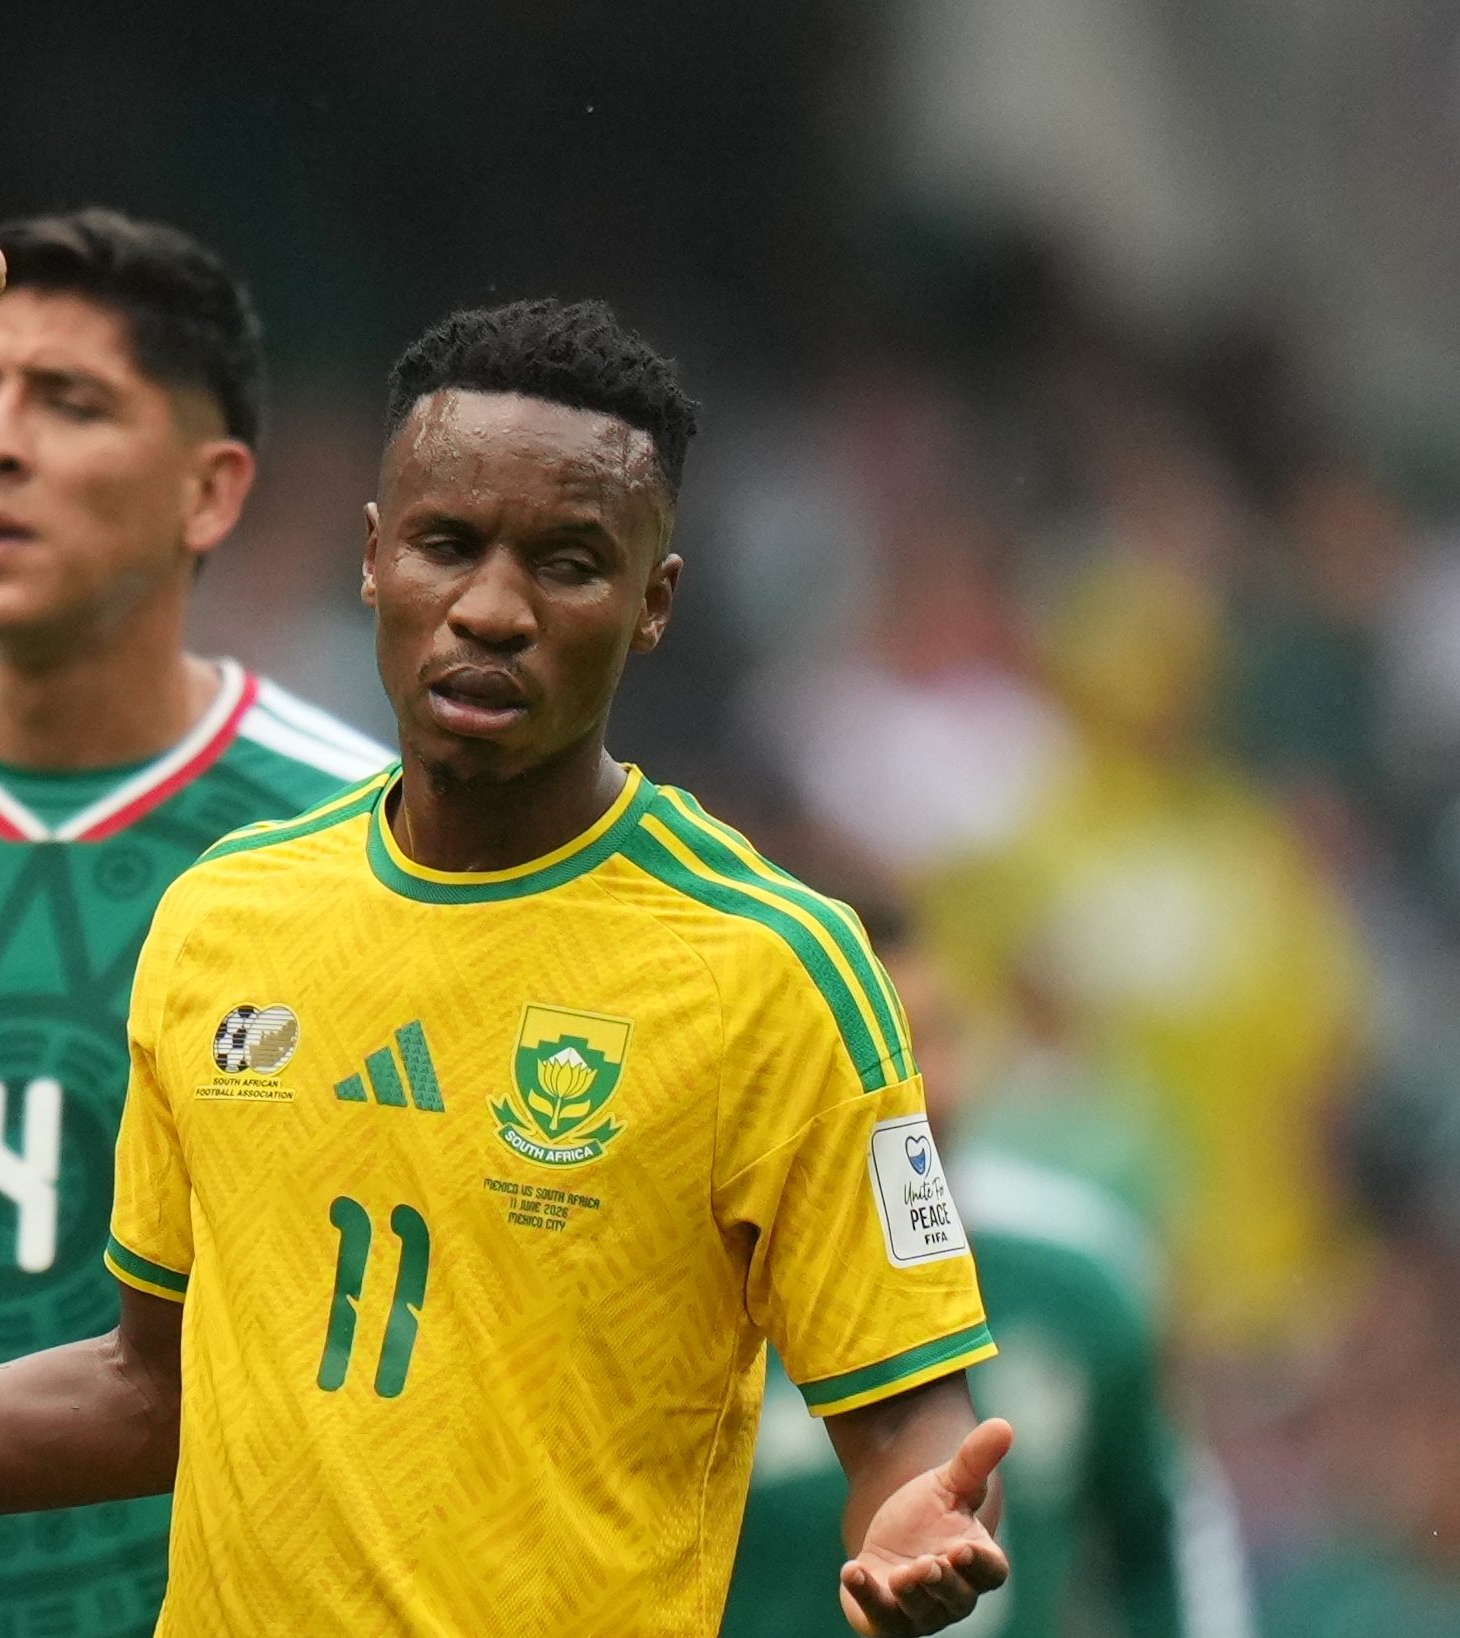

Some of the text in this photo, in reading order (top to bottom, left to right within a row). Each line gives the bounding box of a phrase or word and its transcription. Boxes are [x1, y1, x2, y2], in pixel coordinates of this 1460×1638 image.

[195, 1087, 294, 1099] FOOTBALL ASSOCIATION
[212, 1077, 279, 1088] SOUTH AFRICAN
[504, 1129, 595, 1162] SOUTH AFRICA
[510, 1197, 517, 1210] 11
[543, 1203, 569, 1219] 2026
[535, 1187, 565, 1204] SOUTH
[567, 1193, 600, 1211] AFRICA
[545, 1218, 567, 1233] CITY
[910, 1202, 951, 1231] PEACE
[924, 1231, 949, 1245] FIFA
[316, 1194, 431, 1399] 11
